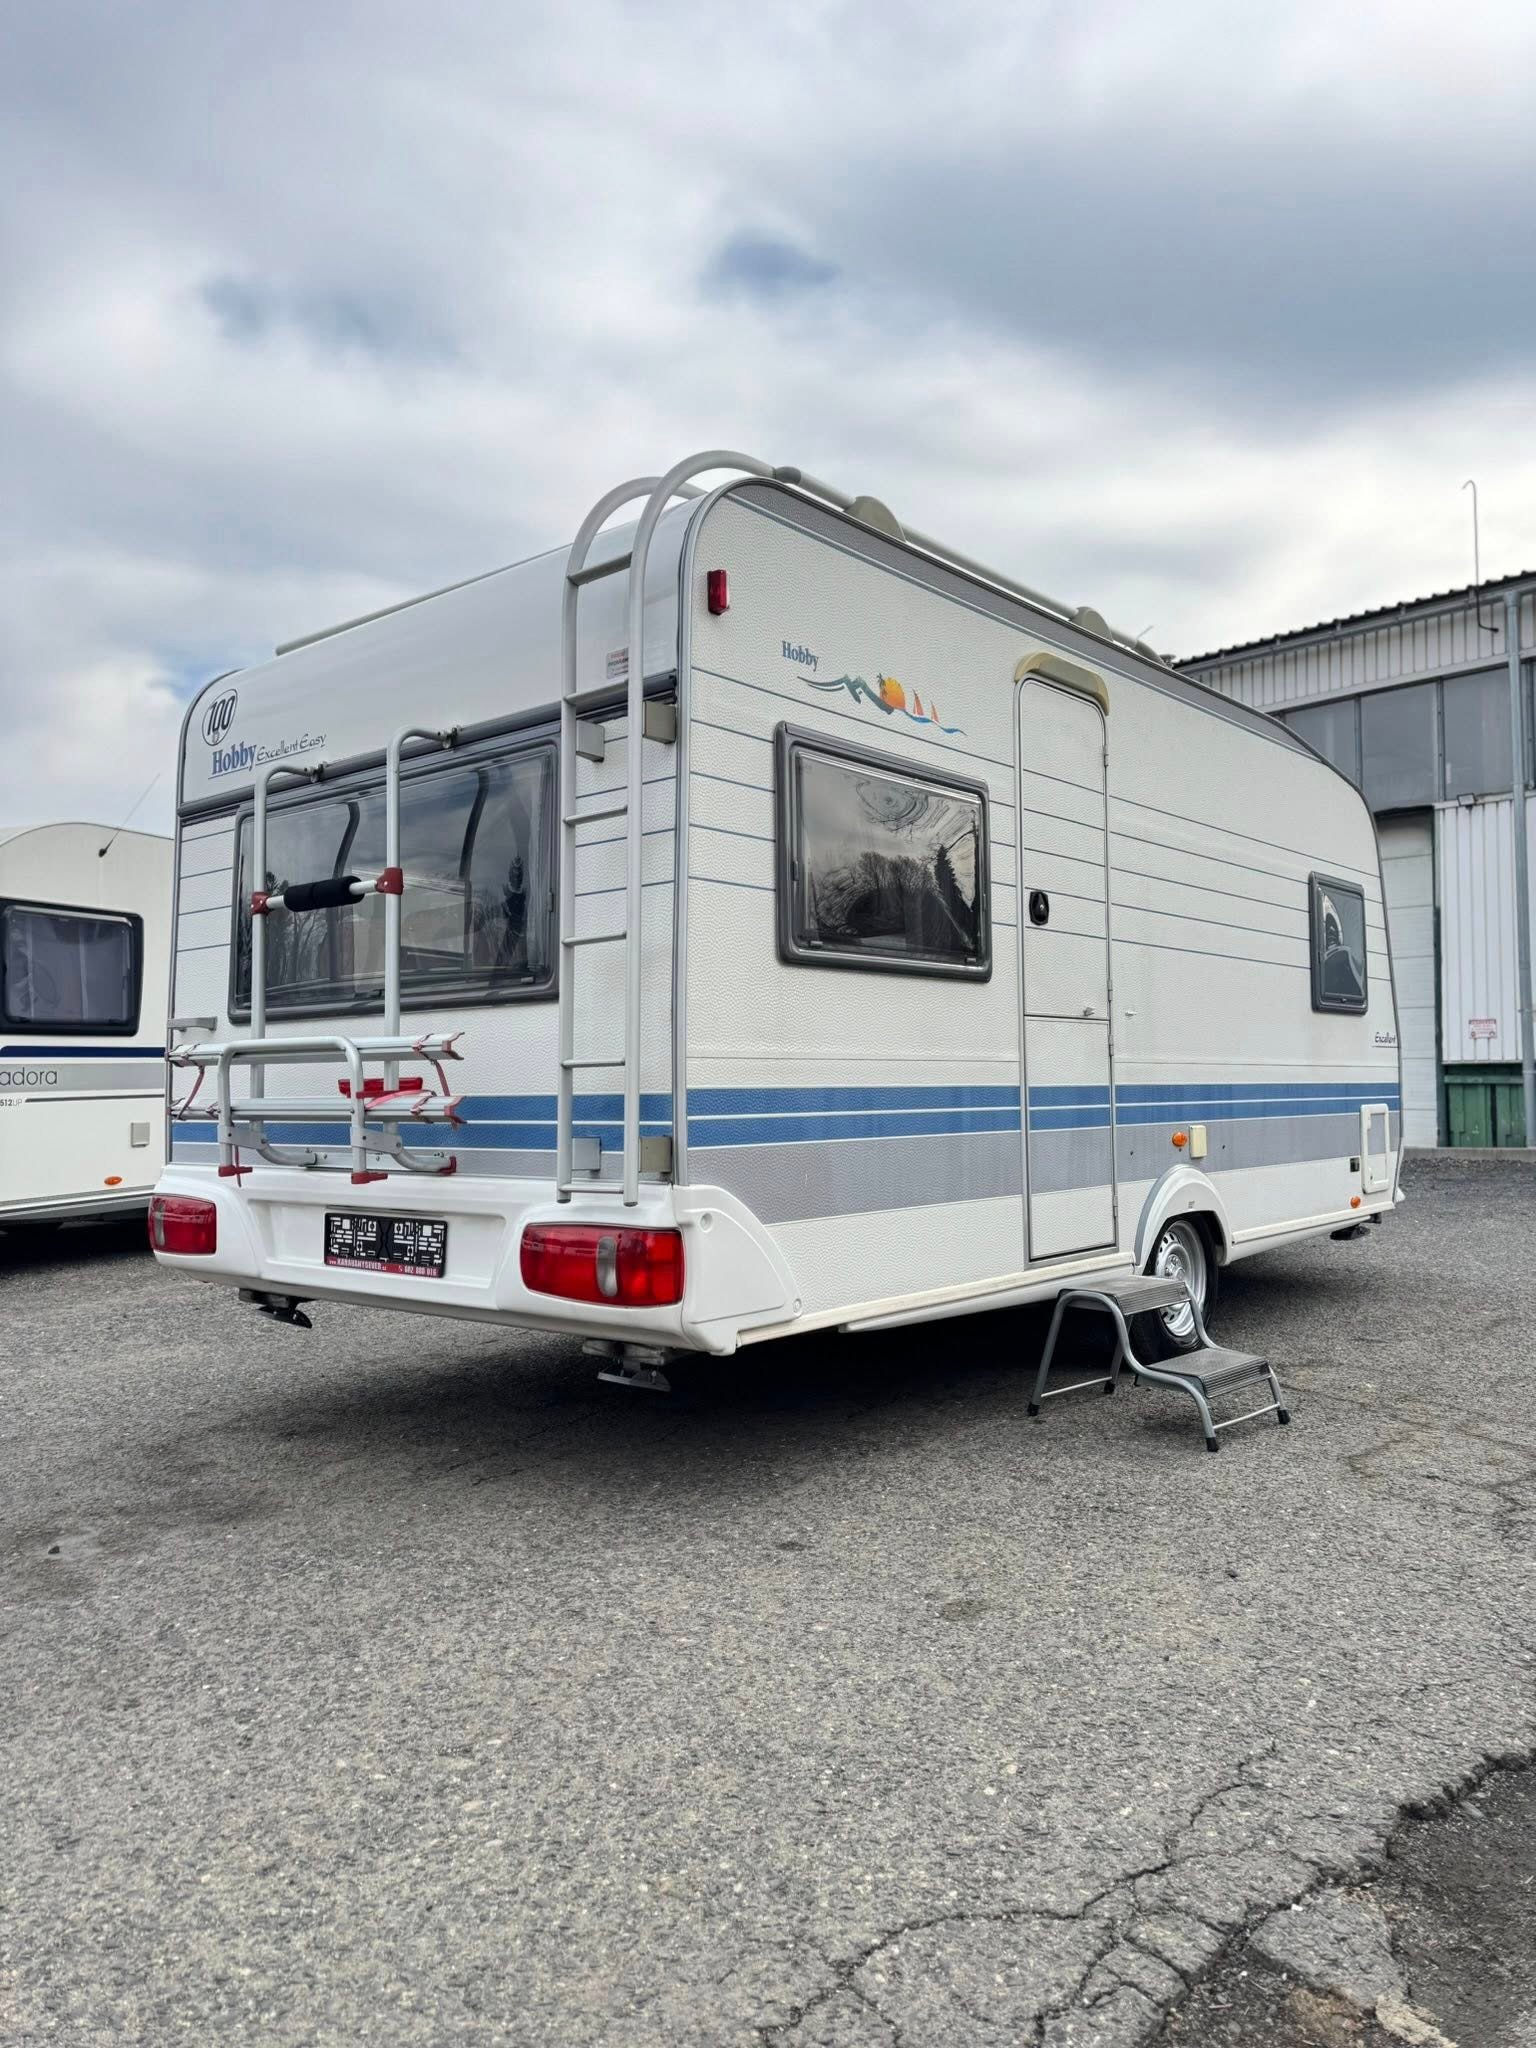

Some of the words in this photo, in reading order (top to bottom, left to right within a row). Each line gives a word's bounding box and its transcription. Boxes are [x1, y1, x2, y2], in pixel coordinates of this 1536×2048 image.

[782, 640, 819, 672] Hobby
[207, 695, 236, 736] 100
[212, 741, 257, 772] Hobby
[256, 739, 299, 762] Excellent
[299, 733, 327, 750] Easy
